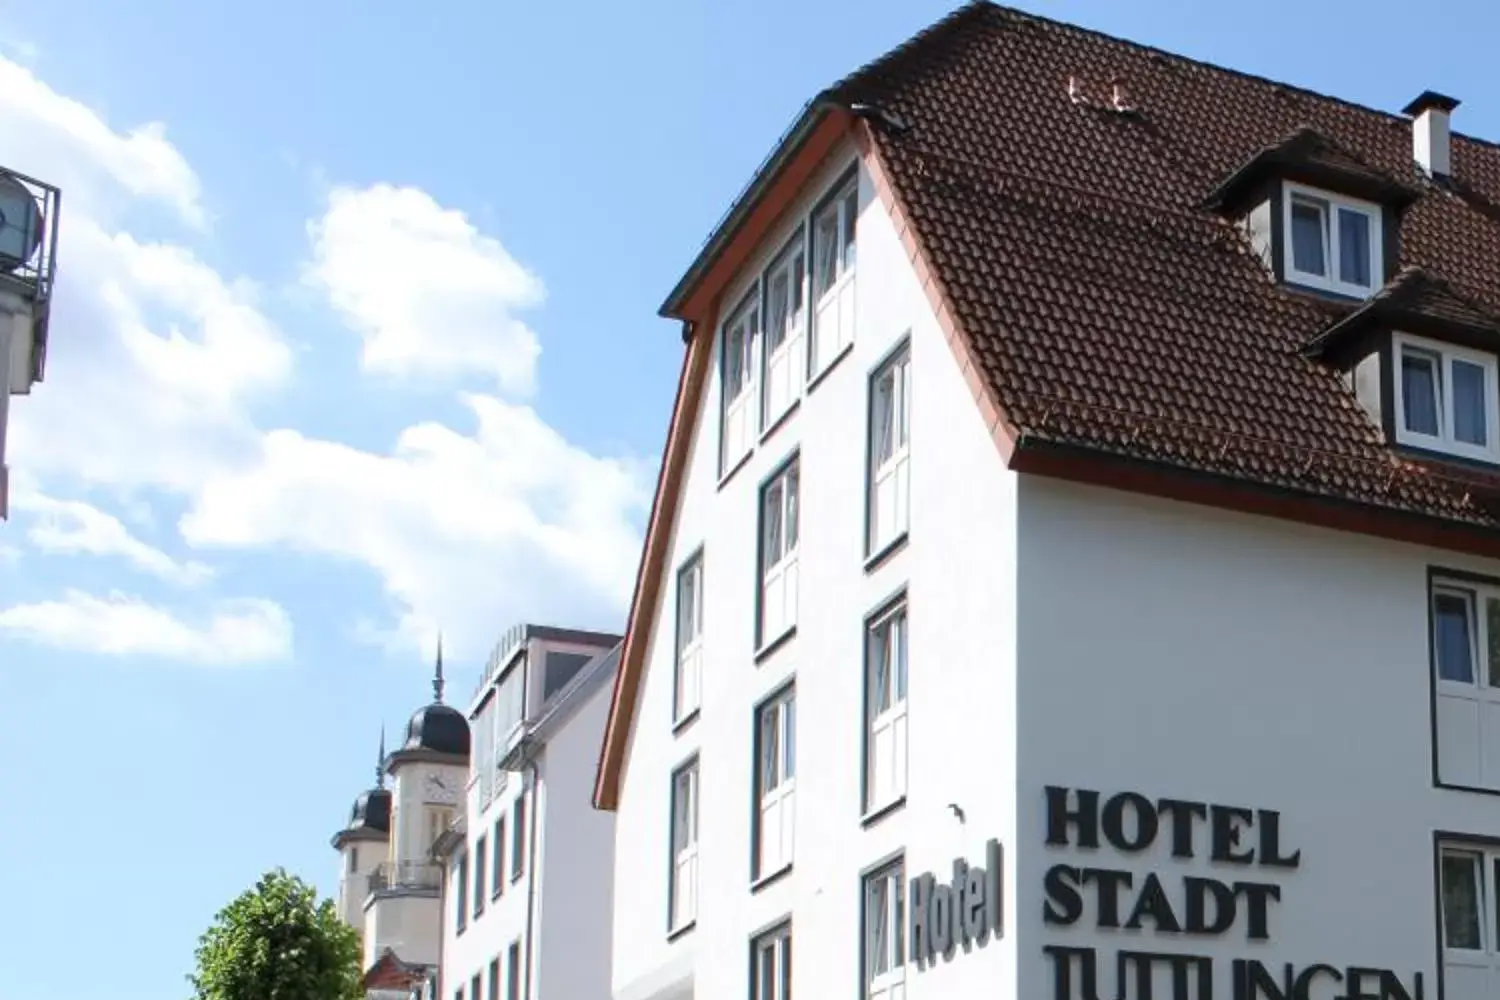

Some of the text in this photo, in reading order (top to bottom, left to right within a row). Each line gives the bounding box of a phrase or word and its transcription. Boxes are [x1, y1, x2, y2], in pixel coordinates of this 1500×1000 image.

[1044, 785, 1301, 867] HOTEL
[910, 838, 1004, 972] Hotel
[1042, 863, 1281, 940] STADT
